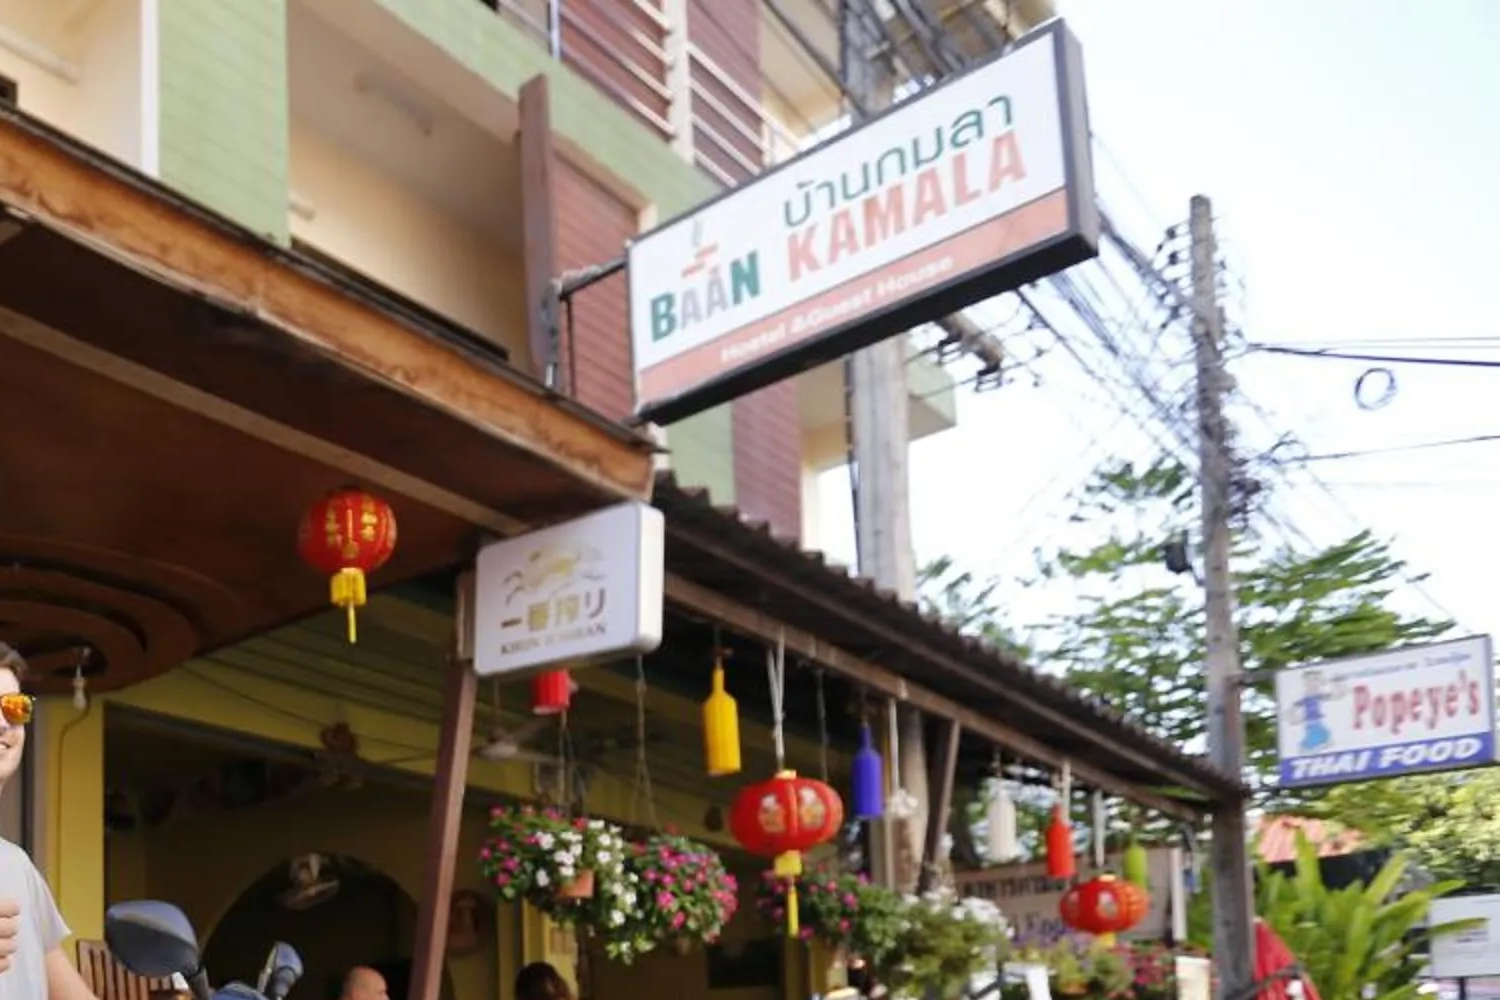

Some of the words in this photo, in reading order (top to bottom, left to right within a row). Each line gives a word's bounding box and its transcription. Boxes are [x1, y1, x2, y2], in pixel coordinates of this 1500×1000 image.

[784, 95, 1013, 227] บ้านกมลา
[786, 130, 1028, 282] KAMALA
[1352, 669, 1480, 735] Popeye's
[1289, 749, 1371, 780] THAI
[1378, 737, 1483, 769] FOOD
